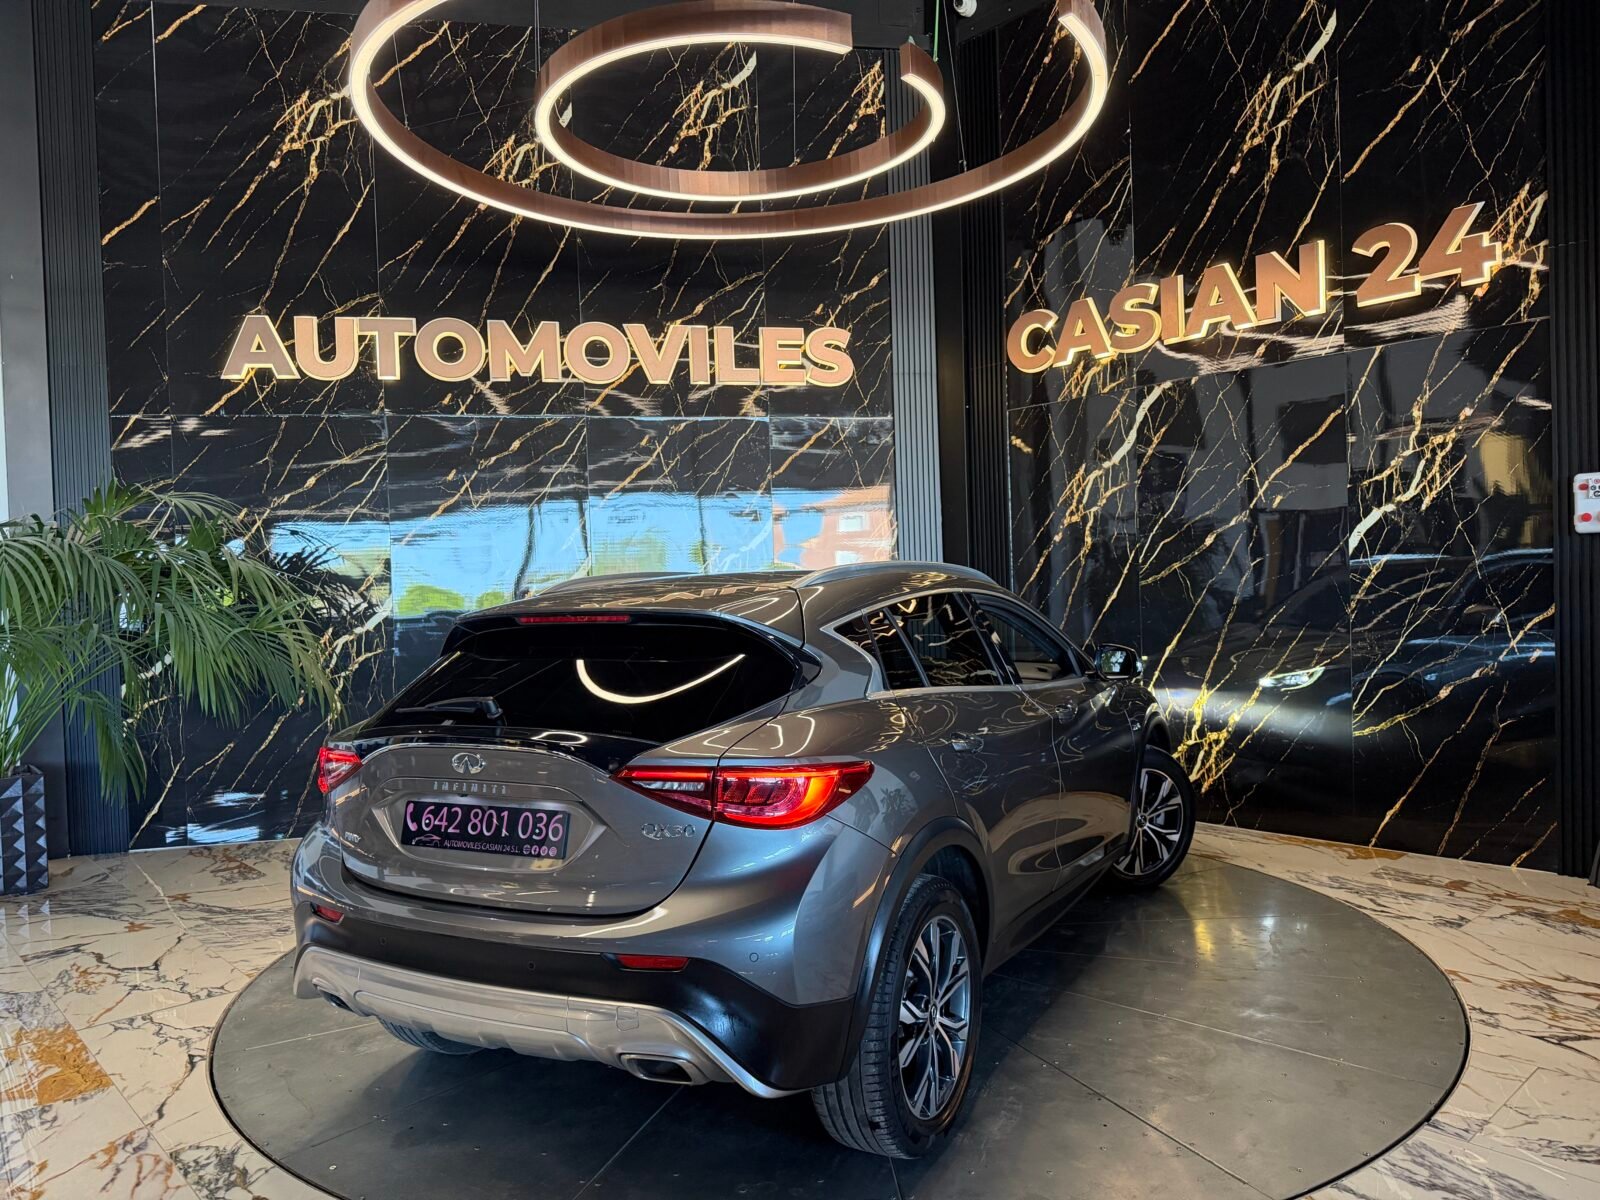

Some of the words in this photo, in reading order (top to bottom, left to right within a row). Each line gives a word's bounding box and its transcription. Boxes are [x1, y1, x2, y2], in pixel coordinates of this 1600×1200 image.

[1007, 240, 1326, 374] CASIAN
[1351, 201, 1503, 308] 24
[220, 314, 854, 387] AUTOMOVILES
[433, 781, 506, 794] INFINITI
[421, 805, 462, 833] 642
[467, 808, 509, 838] 801
[518, 811, 563, 842] 036
[641, 823, 696, 841] QX30
[443, 839, 480, 850] AUTOMOVILES
[481, 843, 503, 852] CASIAN
[502, 845, 511, 853] 24
[511, 845, 521, 853] S.L.
